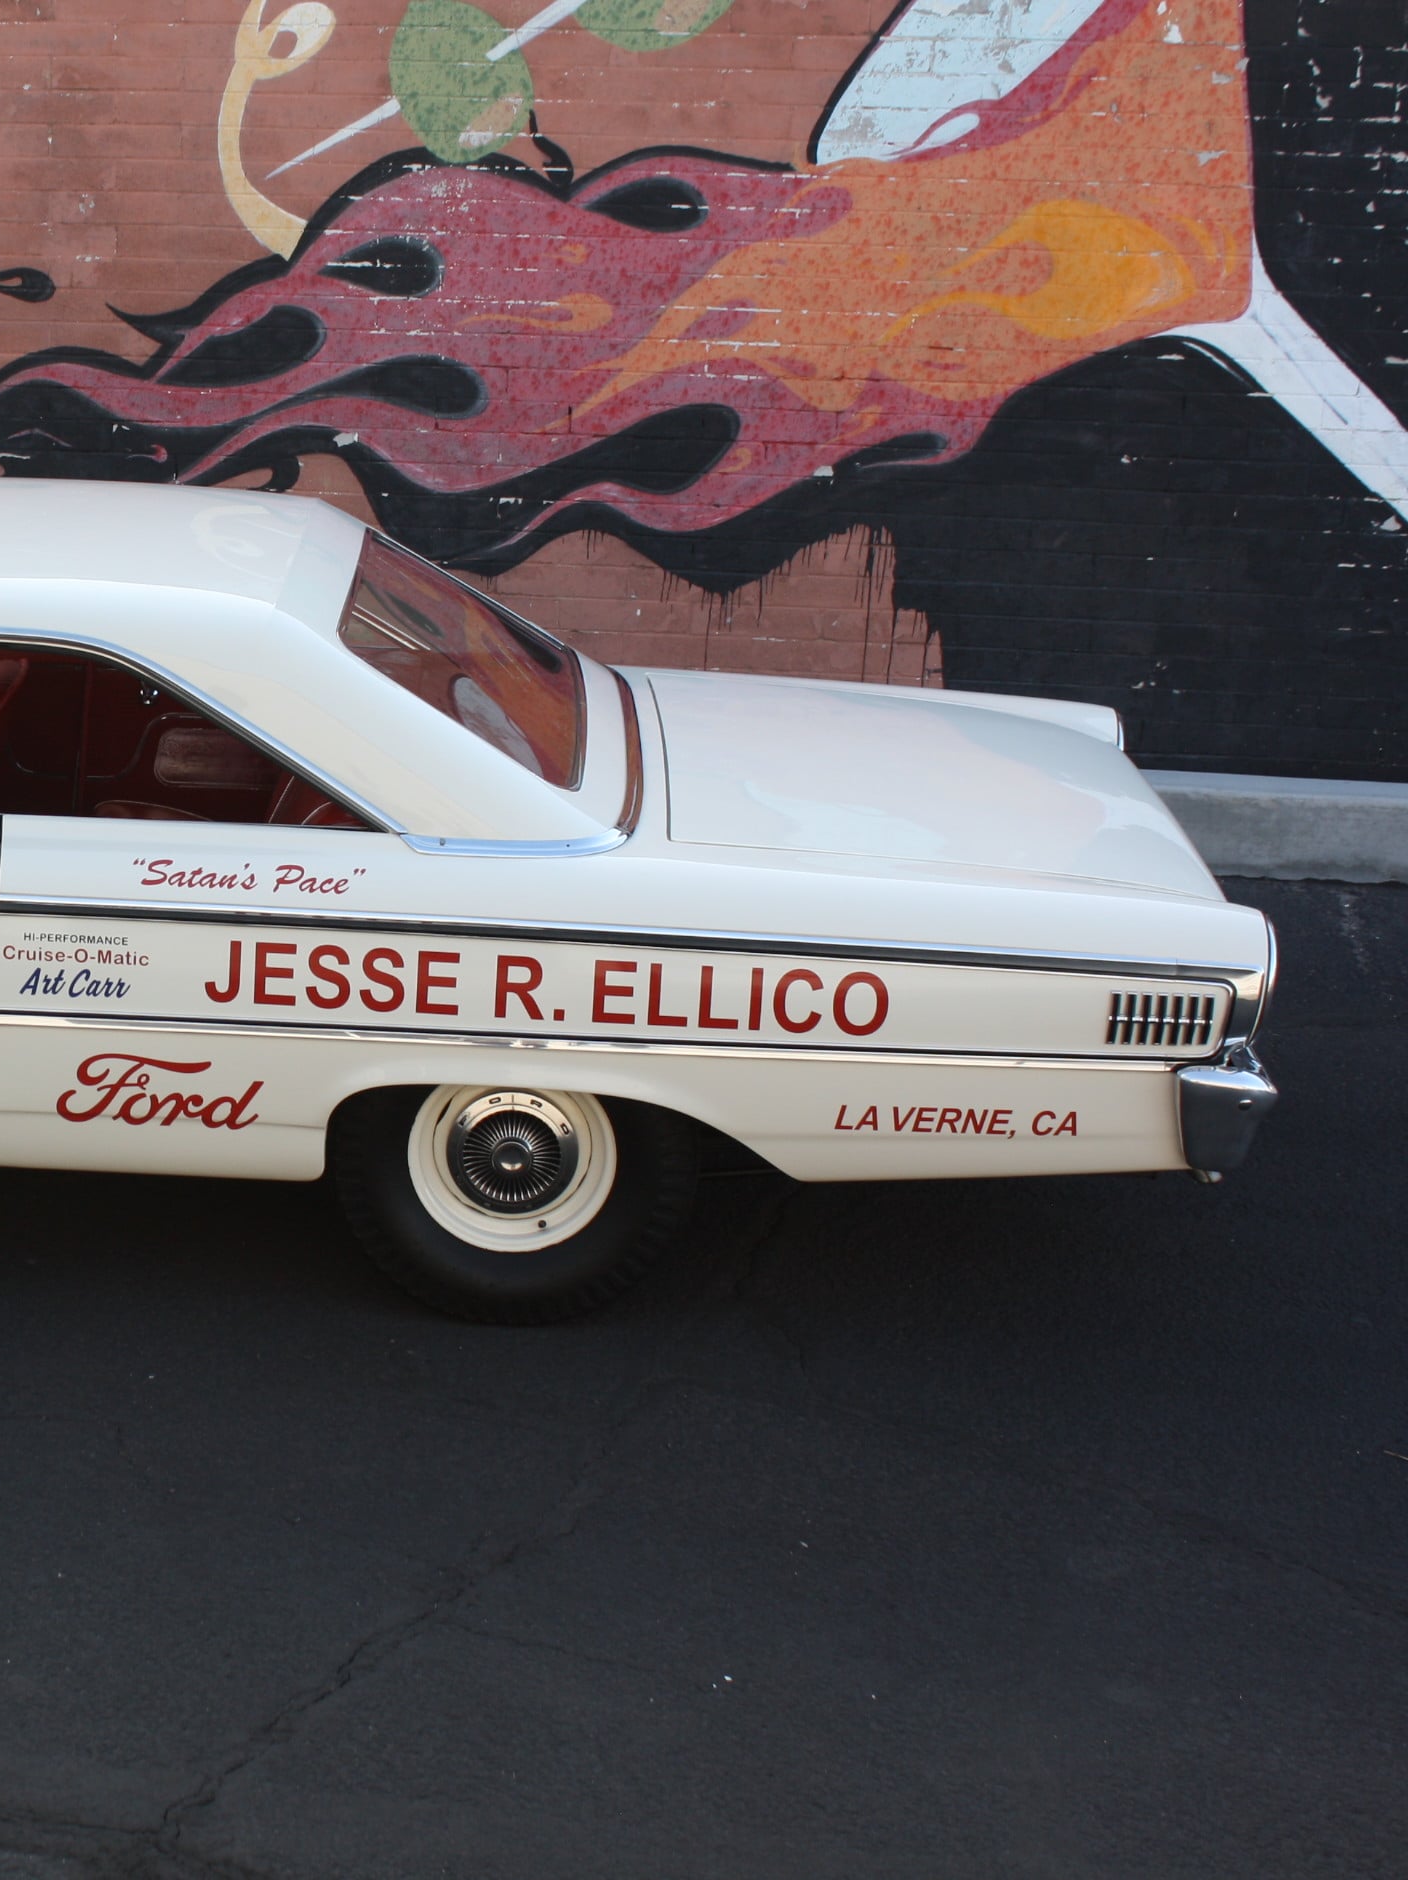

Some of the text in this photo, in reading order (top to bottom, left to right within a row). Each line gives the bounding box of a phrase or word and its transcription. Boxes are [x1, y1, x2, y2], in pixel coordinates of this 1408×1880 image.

[132, 858, 367, 895] "Satan's Pace"
[2, 945, 151, 968] Cruise-O-Matic
[23, 932, 130, 947] HI-PERFORMANCE
[19, 967, 132, 999] Art Carr
[204, 940, 890, 1037] JESSE R. ELLICO
[56, 1053, 265, 1130] Ford
[834, 1104, 1078, 1140] LA VERNE, CA
